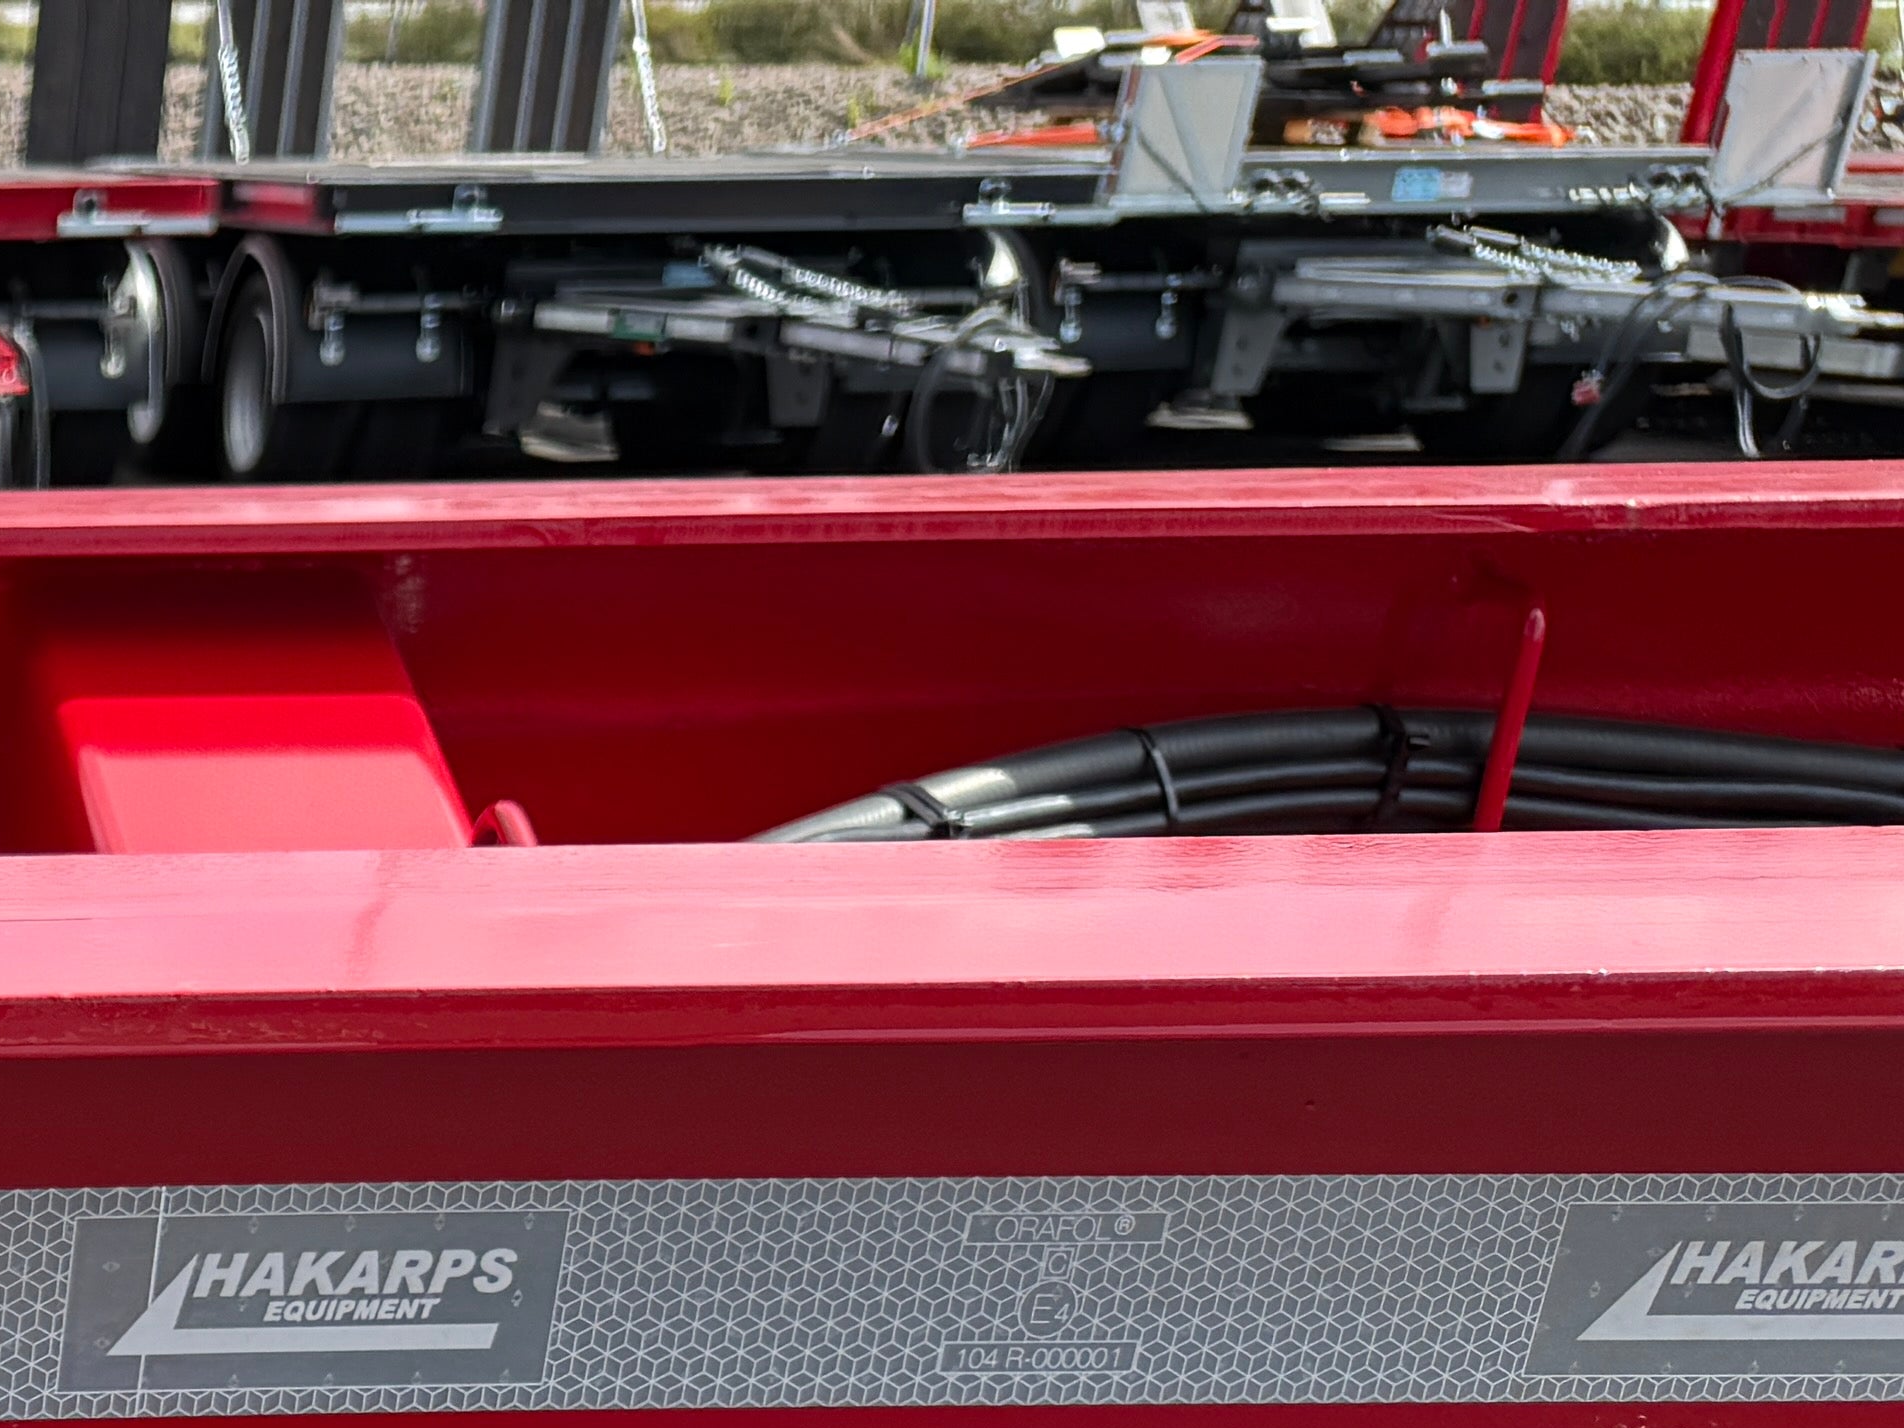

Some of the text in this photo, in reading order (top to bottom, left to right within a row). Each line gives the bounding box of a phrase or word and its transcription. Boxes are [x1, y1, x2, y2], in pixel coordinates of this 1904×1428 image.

[192, 1247, 520, 1298] HAKARPS
[1048, 1251, 1068, 1275] C
[1669, 1240, 1904, 1285] HAKAR
[262, 1297, 442, 1323] EQUIPMENT
[1733, 1288, 1904, 1311] EQUIPMENT
[957, 1346, 1122, 1370] 104 R-000001
